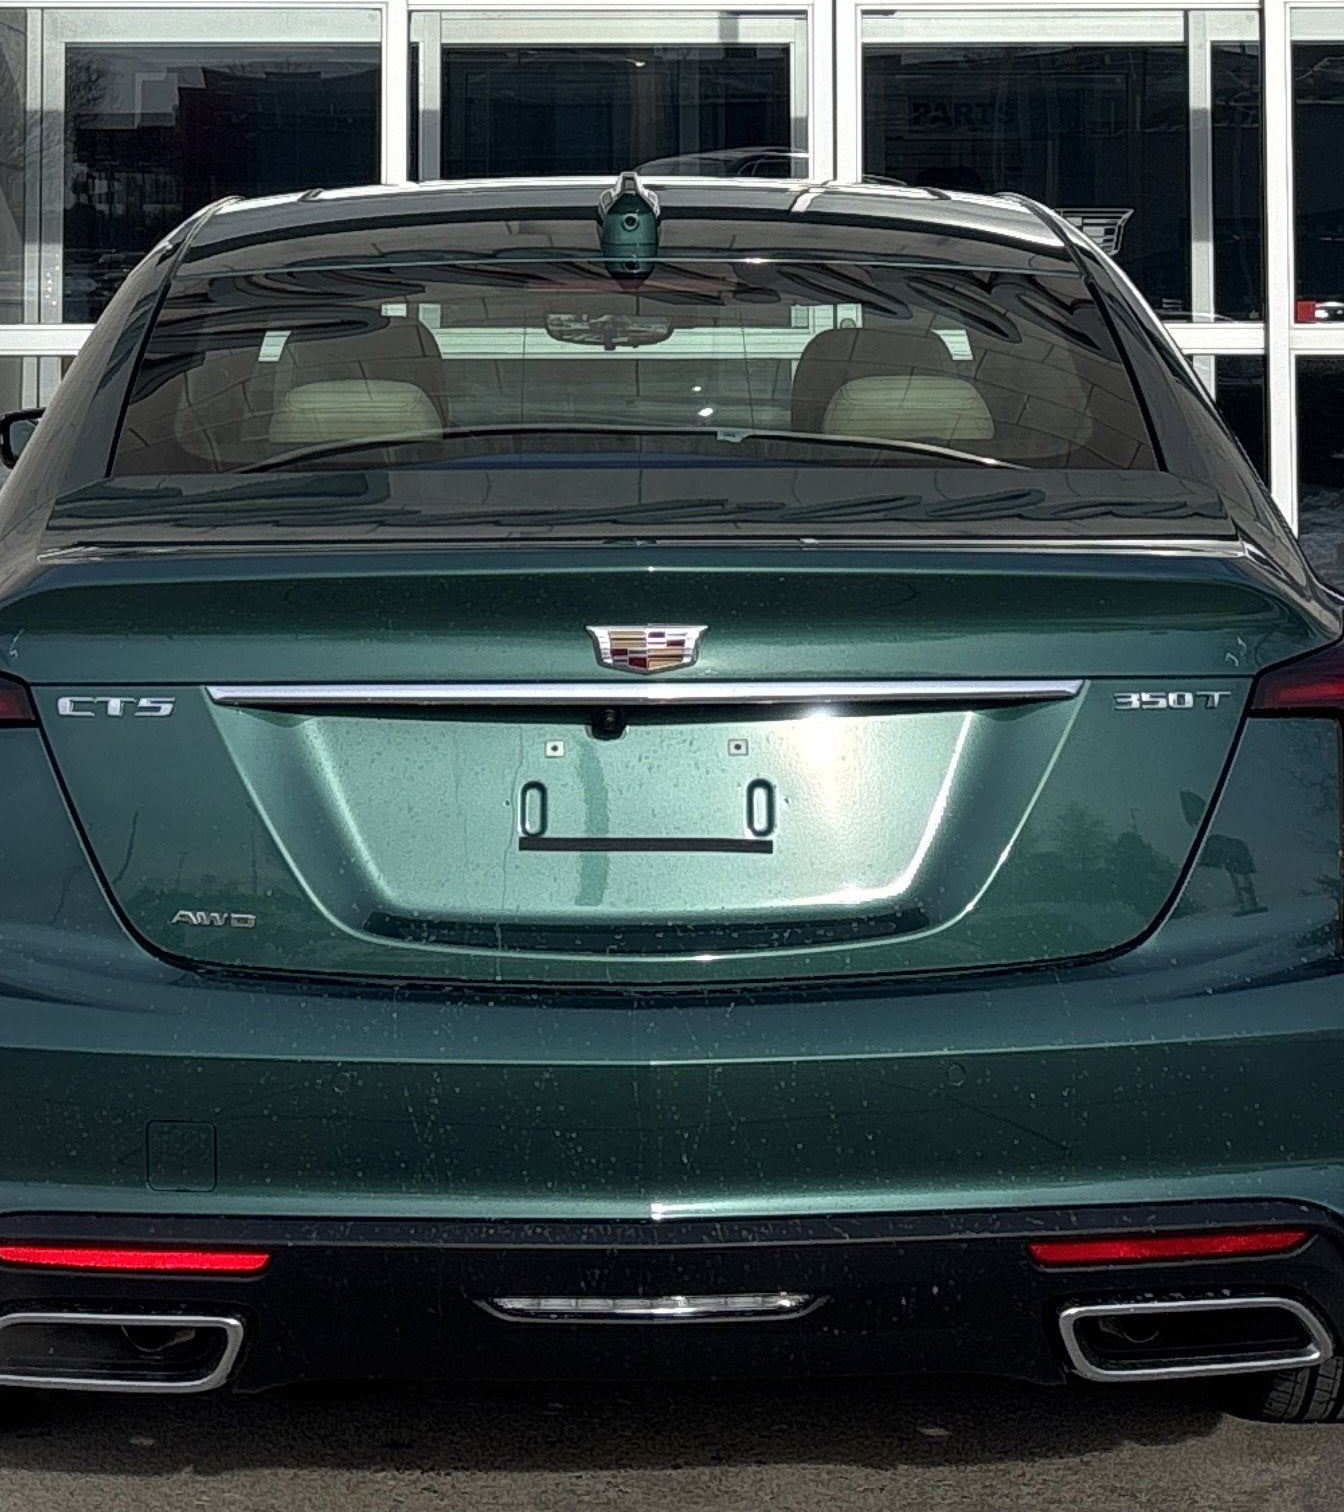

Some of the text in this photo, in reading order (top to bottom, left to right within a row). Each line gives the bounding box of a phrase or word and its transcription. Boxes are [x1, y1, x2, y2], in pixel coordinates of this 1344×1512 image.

[910, 102, 1015, 127] PARTS
[57, 696, 176, 718] CT5
[1112, 691, 1231, 710] 350T
[171, 910, 256, 928] AWD
